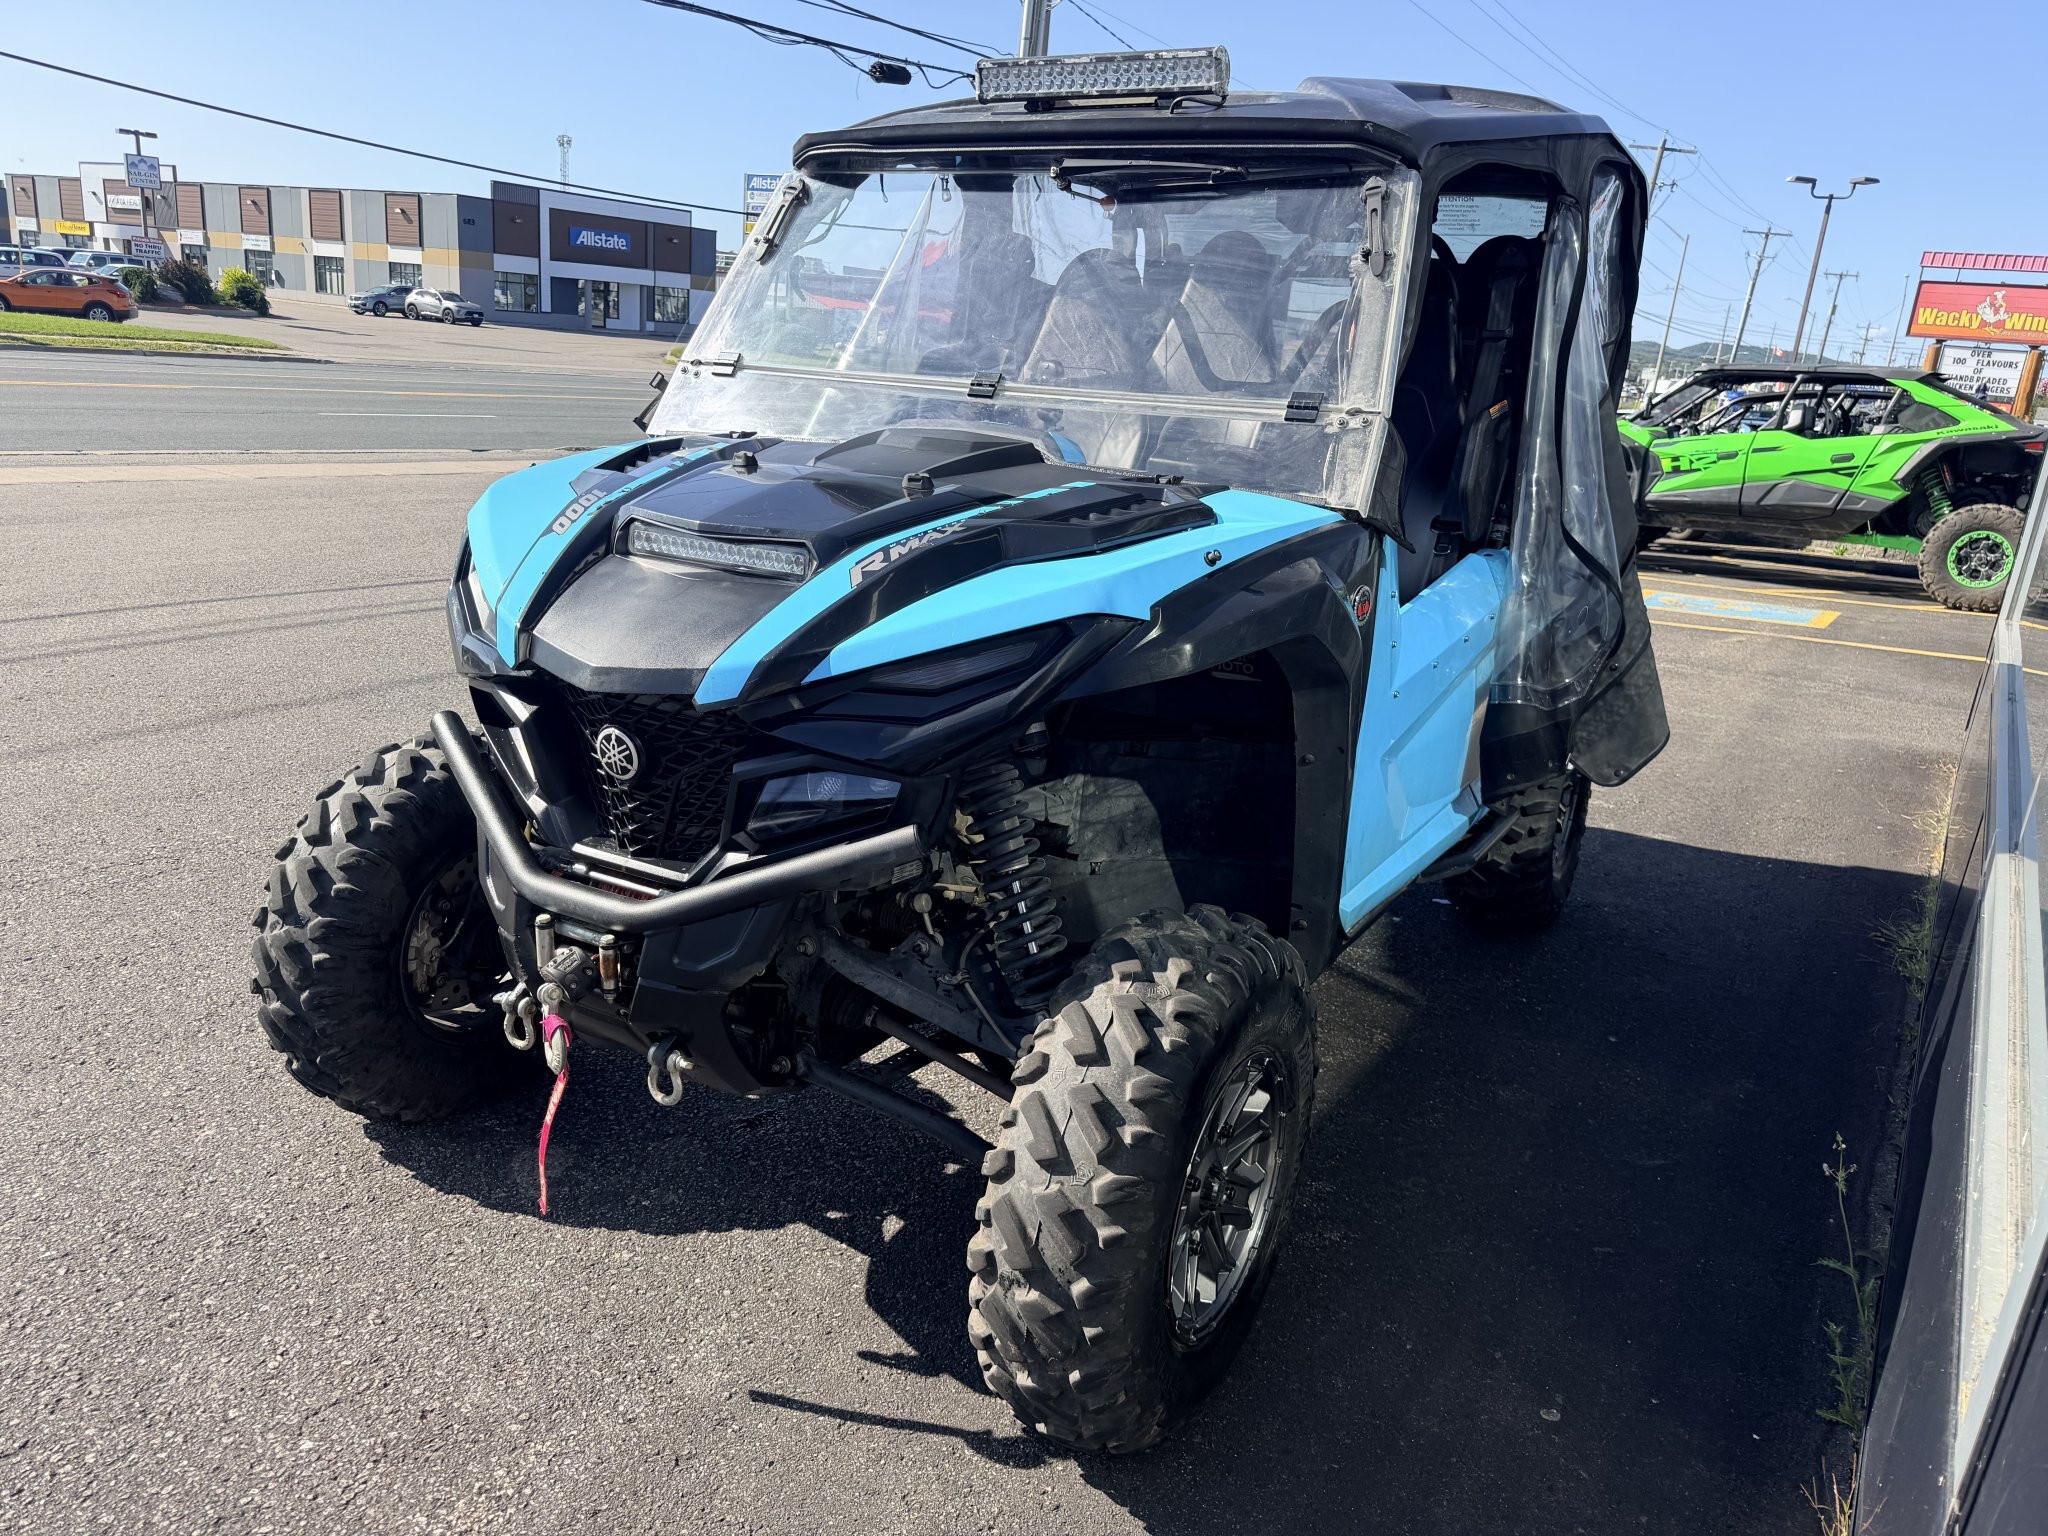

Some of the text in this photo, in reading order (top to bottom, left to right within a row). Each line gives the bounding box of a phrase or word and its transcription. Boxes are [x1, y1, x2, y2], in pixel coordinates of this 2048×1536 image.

[131, 177, 158, 185] CENTRE
[576, 230, 628, 250] Allstate
[135, 248, 161, 256] TRAFFIC
[1917, 307, 1982, 330] Wacky
[1970, 350, 1993, 359] OVER
[1952, 357, 2019, 369] 100 FLAVOURS
[1973, 367, 1984, 375] OF
